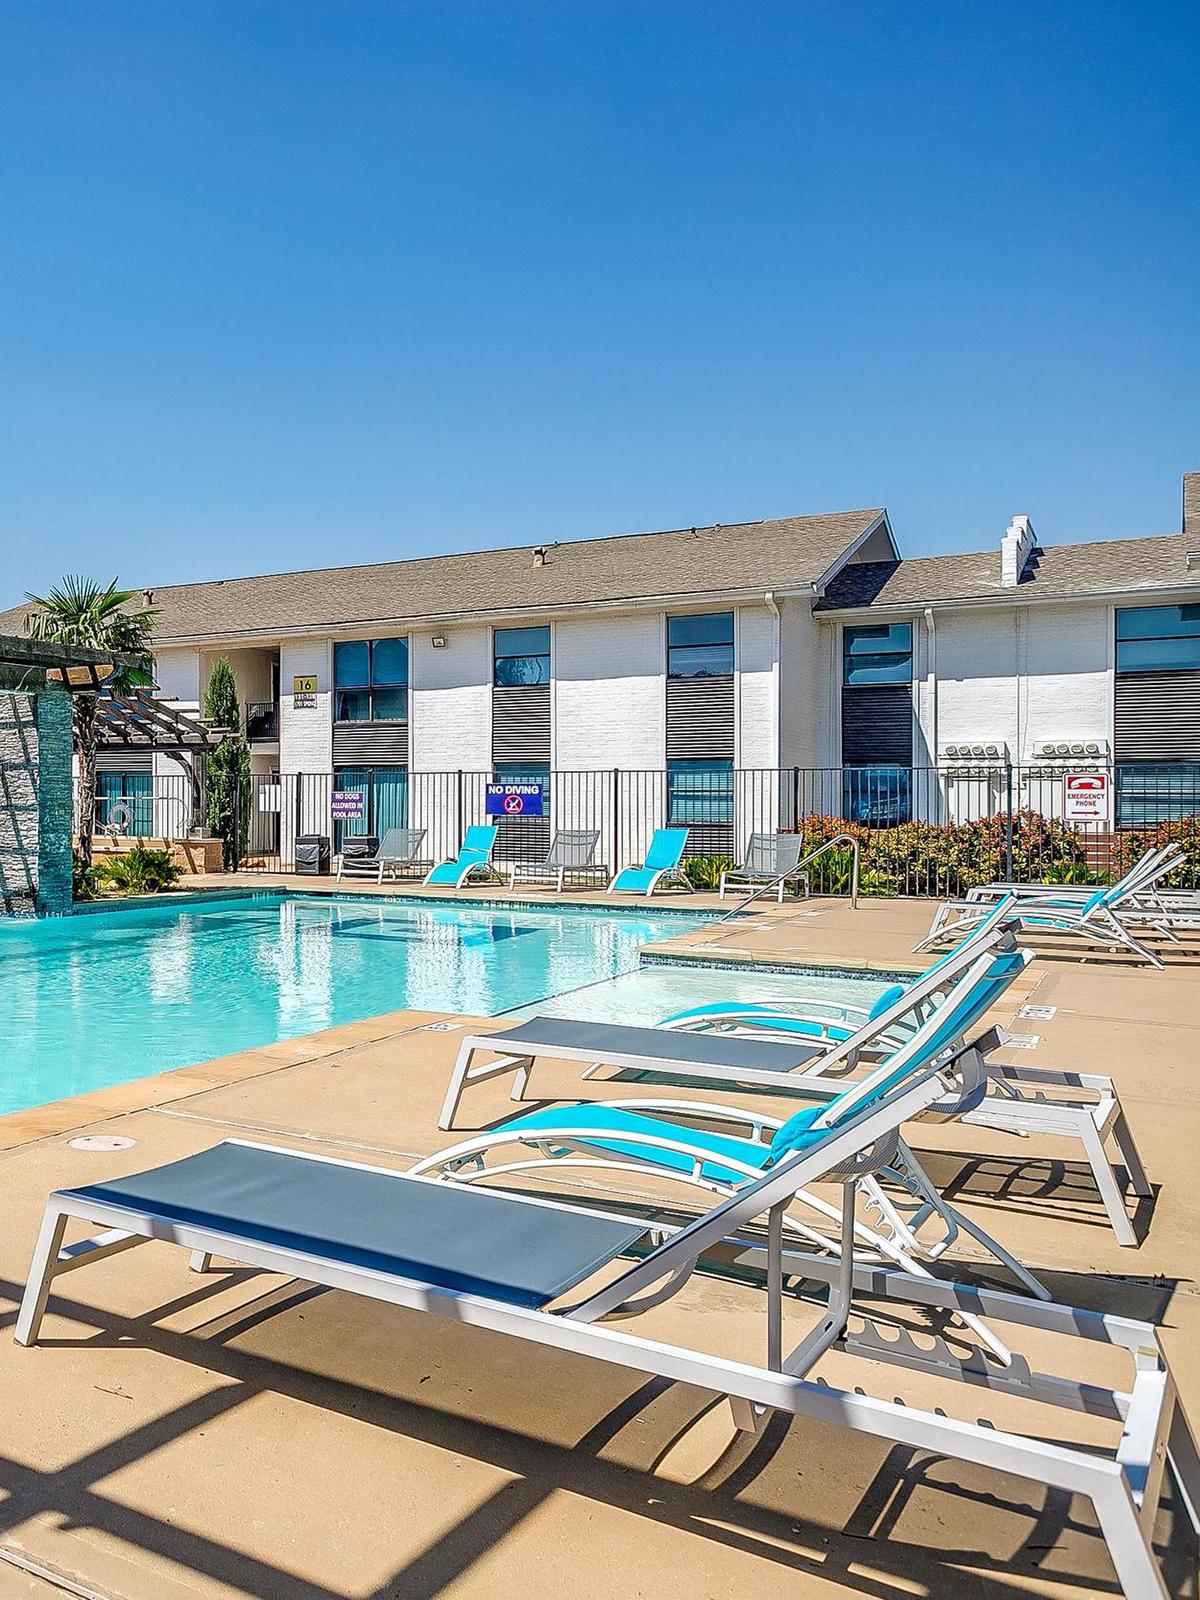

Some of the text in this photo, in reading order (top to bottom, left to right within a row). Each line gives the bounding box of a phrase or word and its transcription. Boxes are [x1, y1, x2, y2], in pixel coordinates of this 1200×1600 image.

[300, 680, 312, 691] 16
[488, 785, 539, 795] NO DIVING
